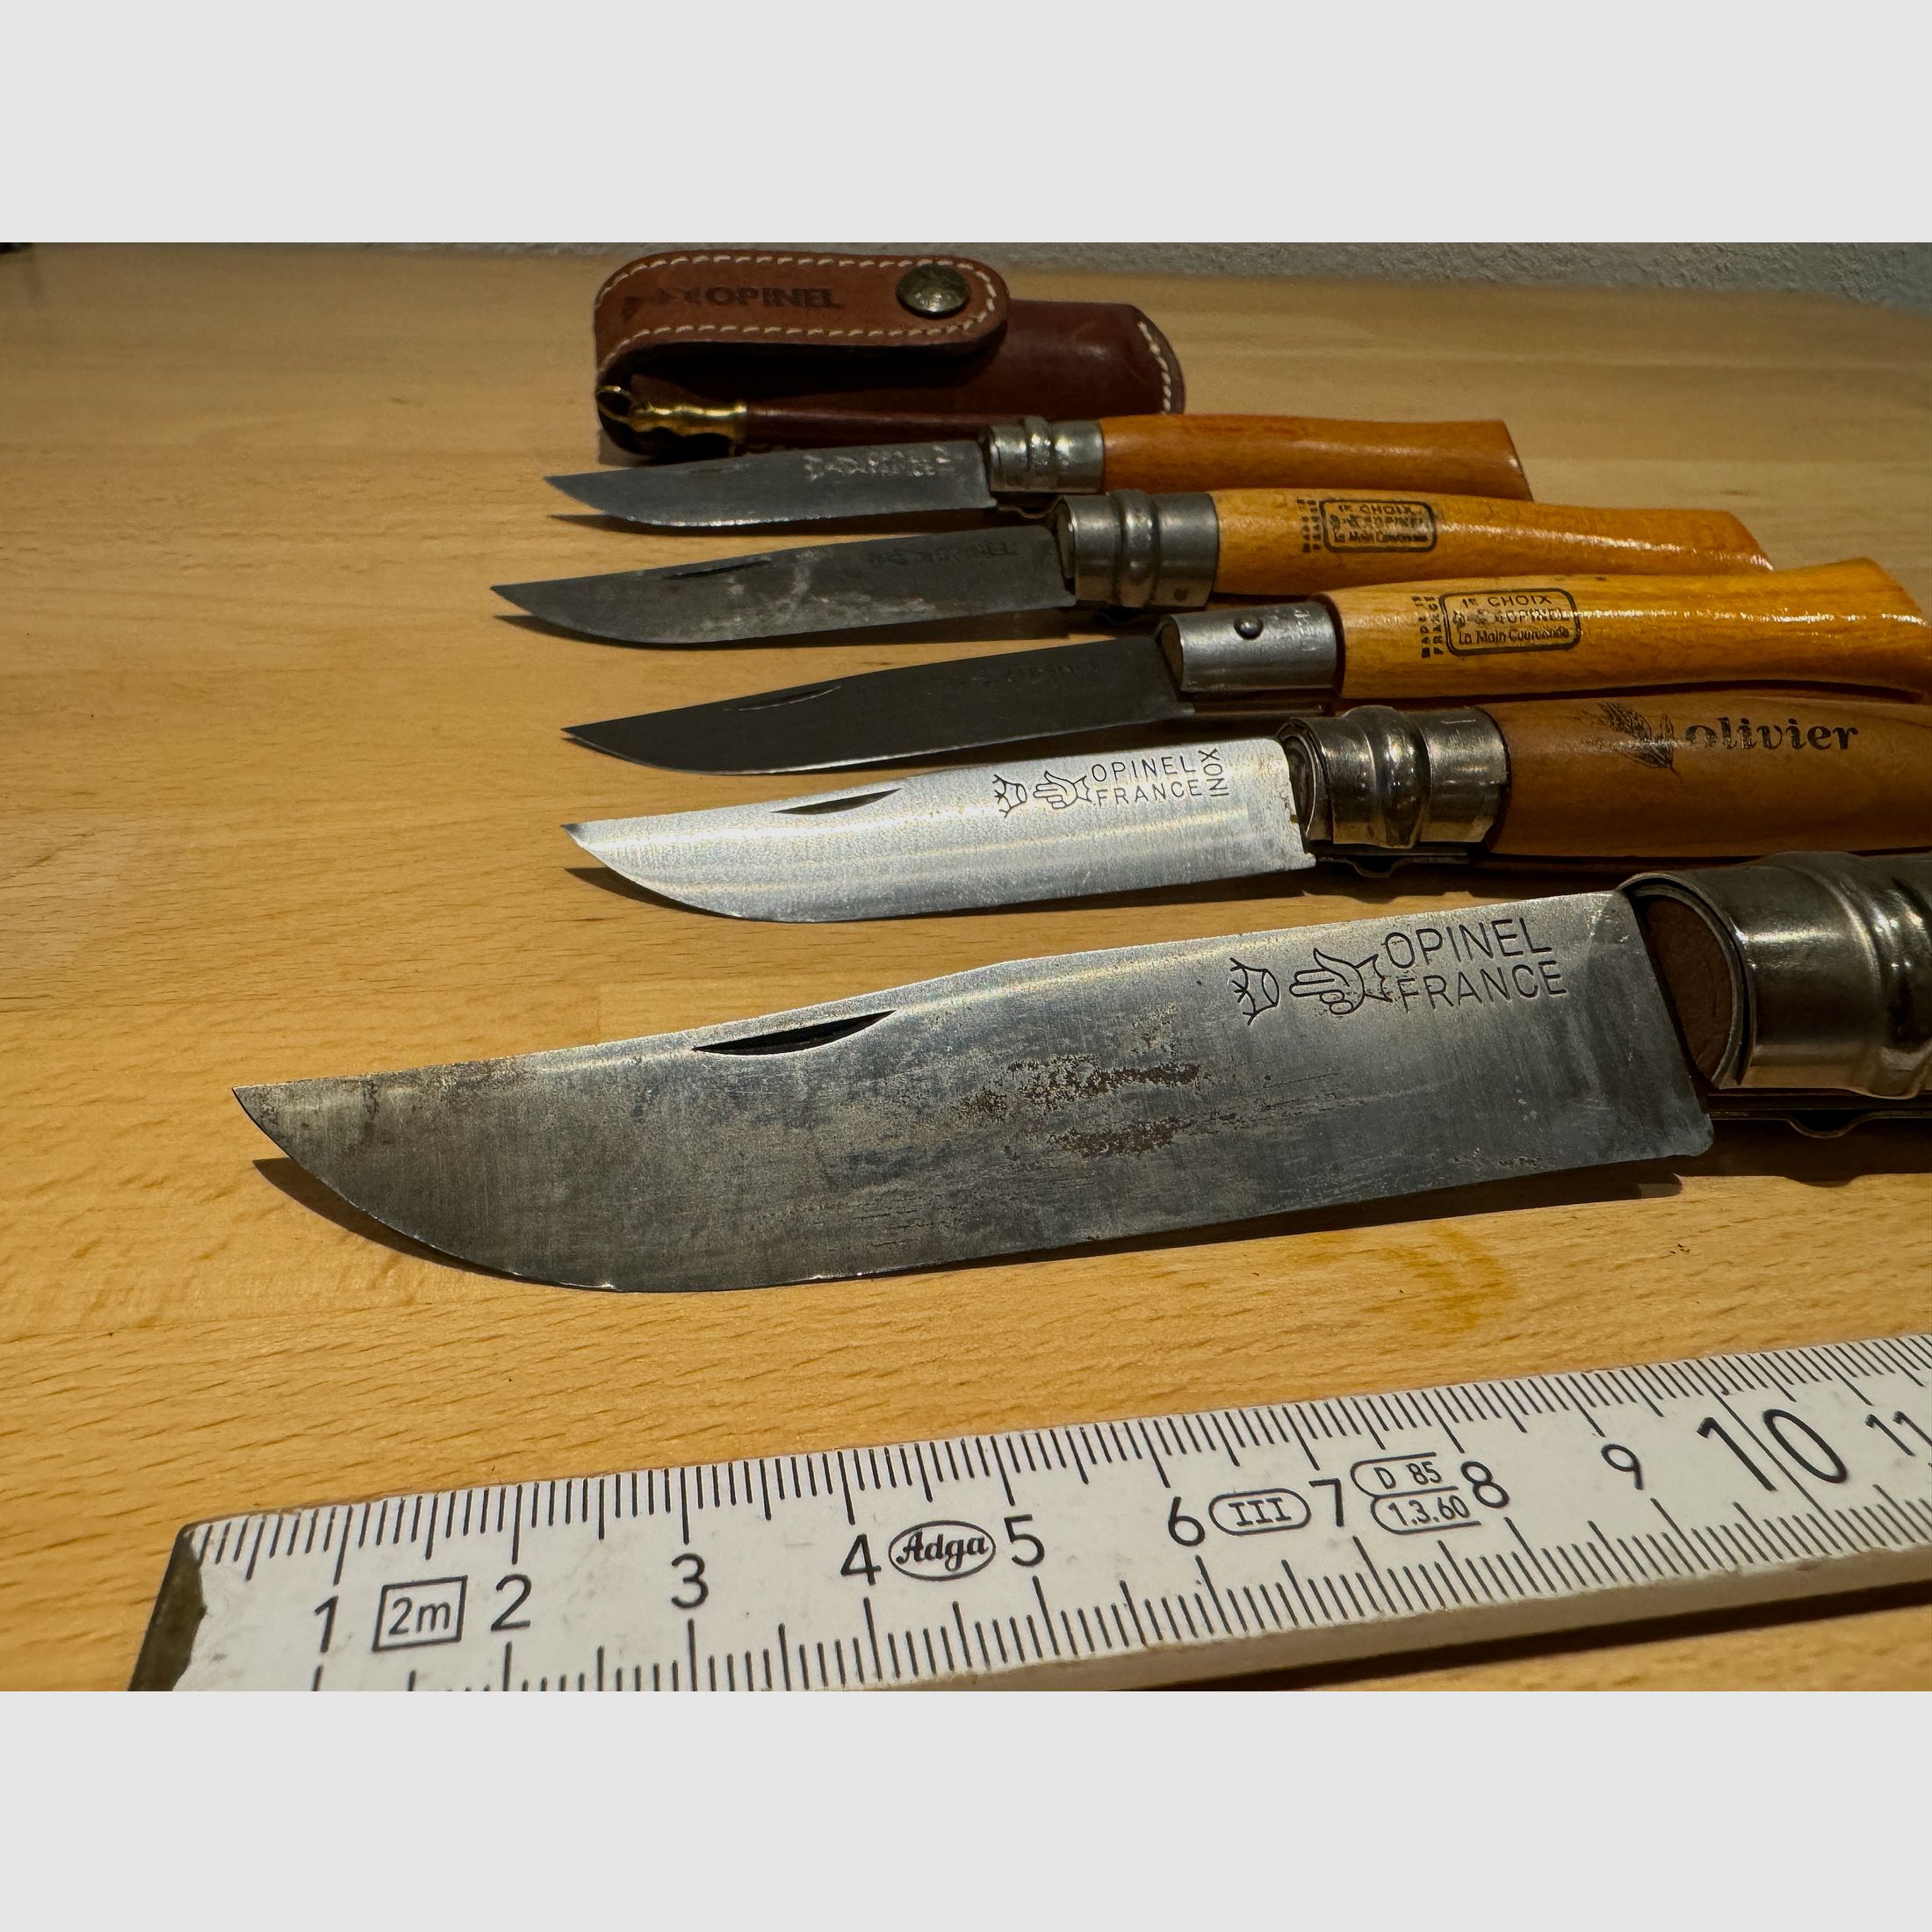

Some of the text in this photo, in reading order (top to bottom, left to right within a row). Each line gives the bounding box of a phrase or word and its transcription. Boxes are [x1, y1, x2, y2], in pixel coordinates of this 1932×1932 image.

[705, 285, 843, 308] OPINEL
[1488, 595, 1552, 607] CHOIX
[1685, 717, 1858, 750] olivier
[1091, 755, 1196, 782] OPINEL
[1198, 748, 1229, 797] INOX
[1096, 779, 1202, 806] FRANCE
[1384, 917, 1552, 969] OPINEL
[1396, 960, 1567, 1013] FRANCE
[1373, 1461, 1442, 1489] D 85
[1388, 1496, 1470, 1525] 1.3.60
[314, 1409, 1932, 1653] 1 2 3 4 5 6 7 8 9 10 11
[896, 1532, 989, 1572] Adga
[389, 1597, 451, 1635] 2m
